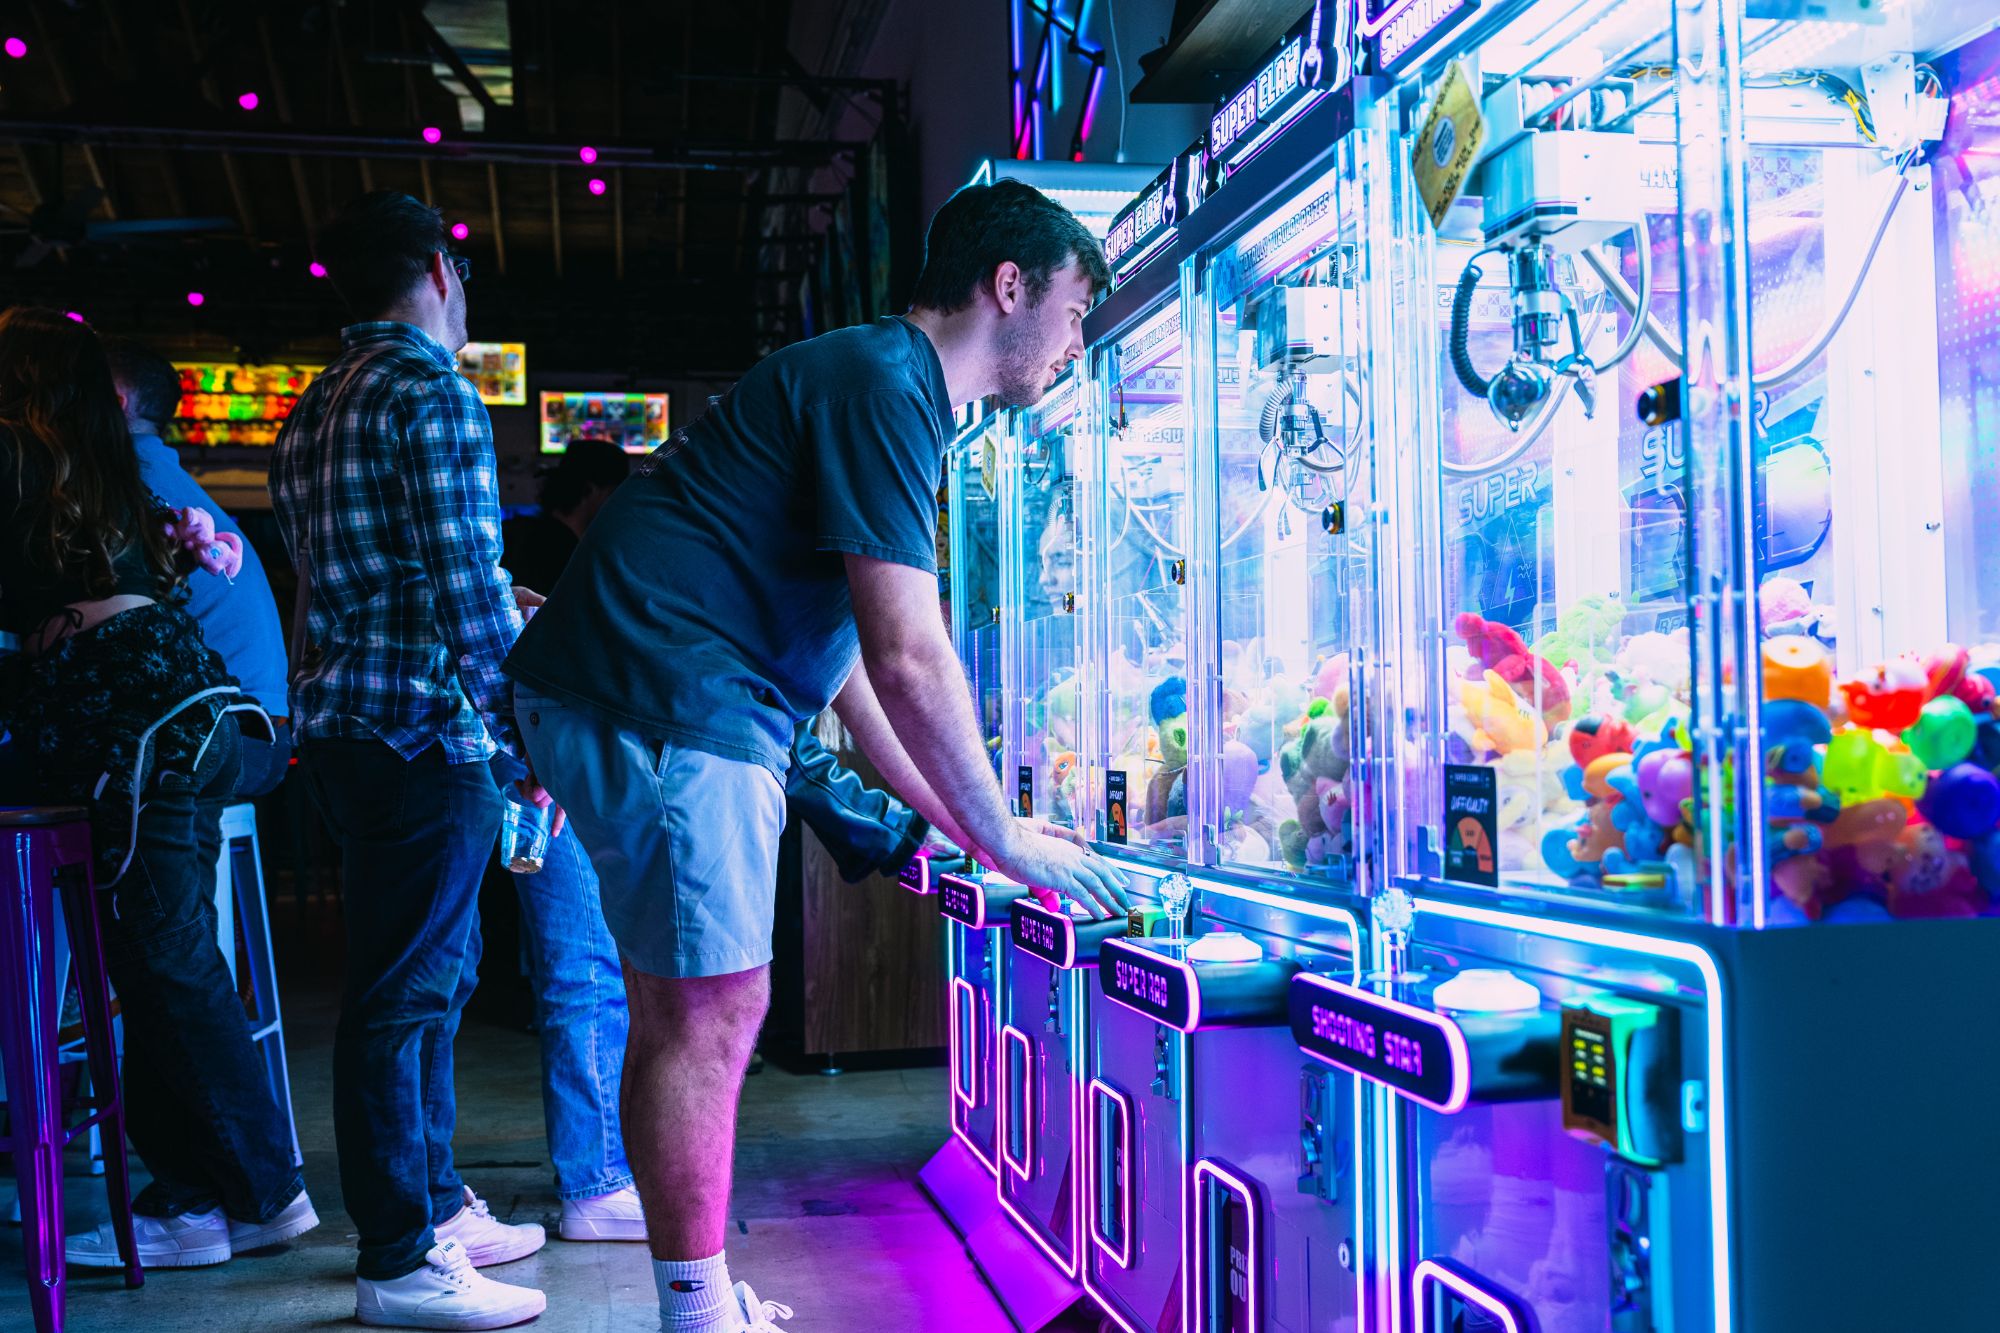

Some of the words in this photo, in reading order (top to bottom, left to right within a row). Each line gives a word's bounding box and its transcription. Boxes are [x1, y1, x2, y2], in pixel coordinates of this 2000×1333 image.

[1212, 84, 1256, 155] SUPER
[1258, 39, 1300, 113] CLAW
[1104, 214, 1135, 263] SUPER
[1135, 187, 1164, 241] CLAW
[1300, 191, 1330, 231] PRIZES
[1457, 460, 1538, 527] SUPER
[1147, 972, 1168, 1008] RAD
[1312, 1004, 1377, 1058] SHOOTING
[1383, 1030, 1423, 1078] STAR
